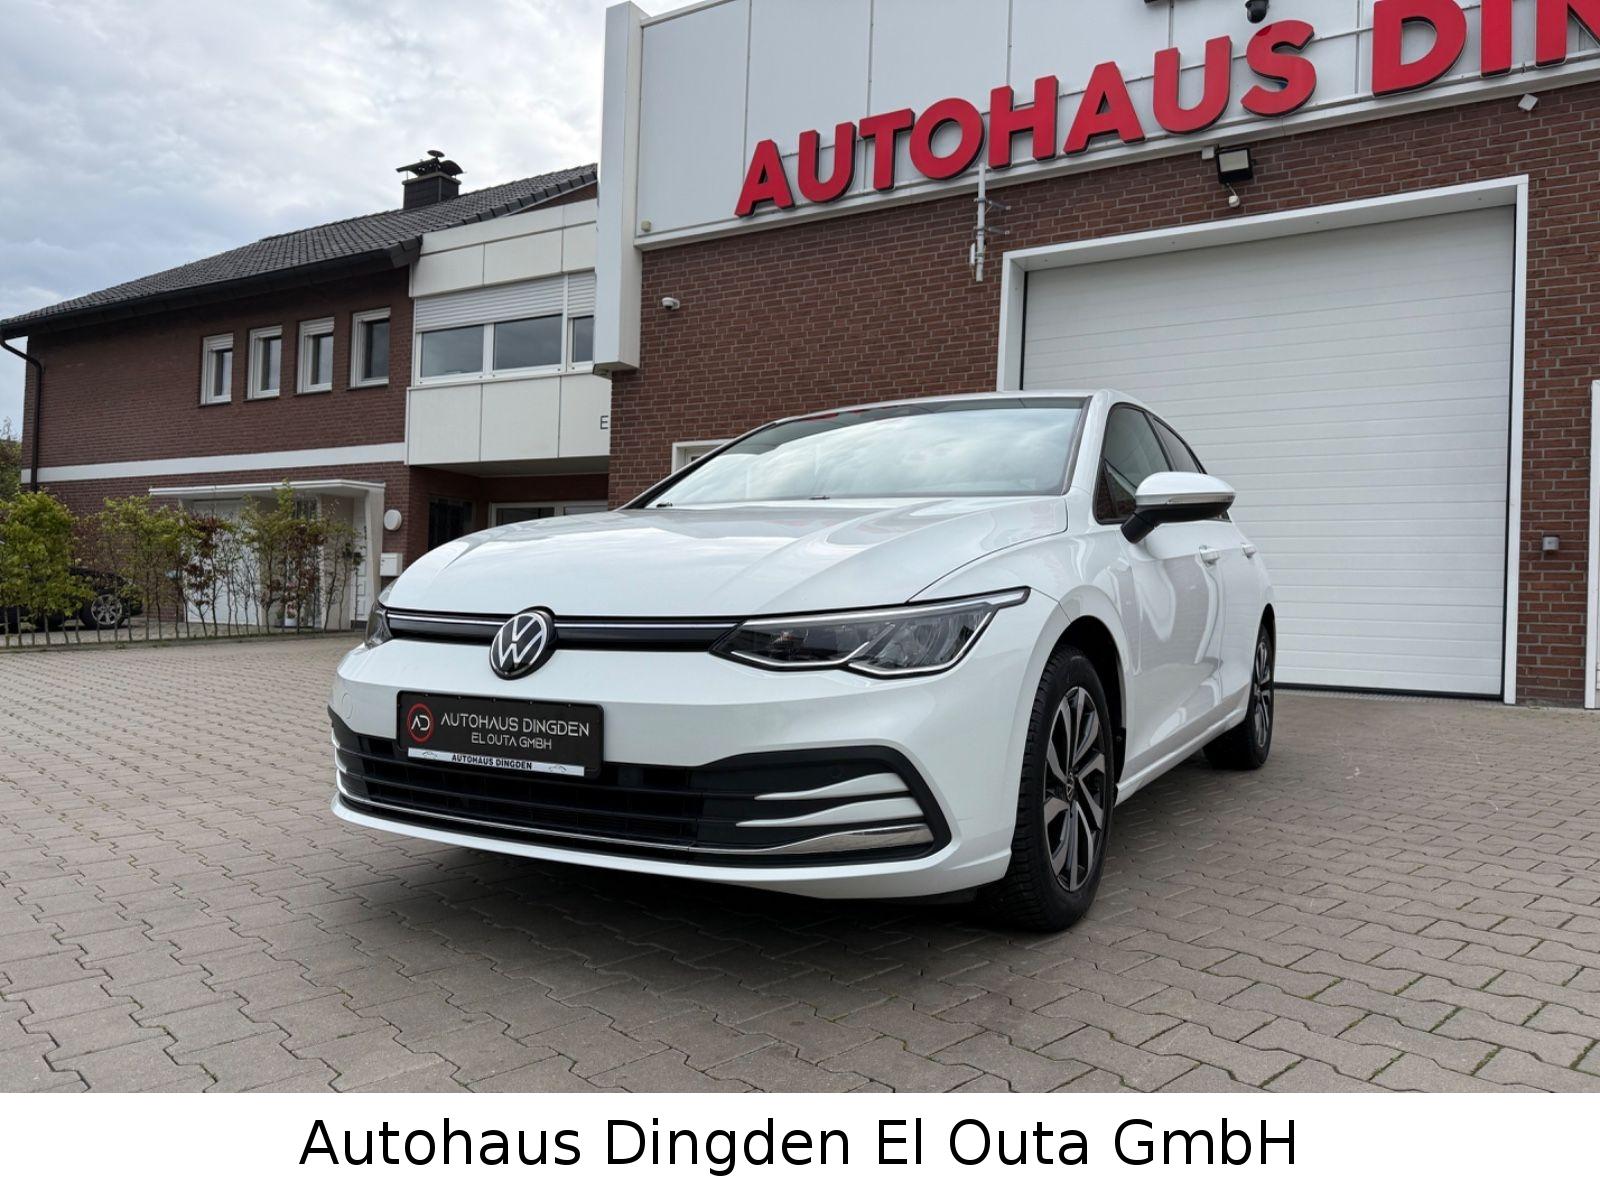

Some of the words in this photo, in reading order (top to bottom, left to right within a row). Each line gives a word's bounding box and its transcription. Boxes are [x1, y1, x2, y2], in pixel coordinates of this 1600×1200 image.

[736, 20, 1318, 216] AUTOHAUS
[600, 415, 609, 430] E
[440, 712, 519, 732] AUTOHAUS
[523, 718, 590, 737] DINGDEN
[471, 732, 486, 745] EL
[487, 733, 517, 747] OUTA
[519, 736, 552, 750] GMBH
[451, 754, 494, 767] AUTOHAUS
[495, 758, 532, 770] DINGDEN
